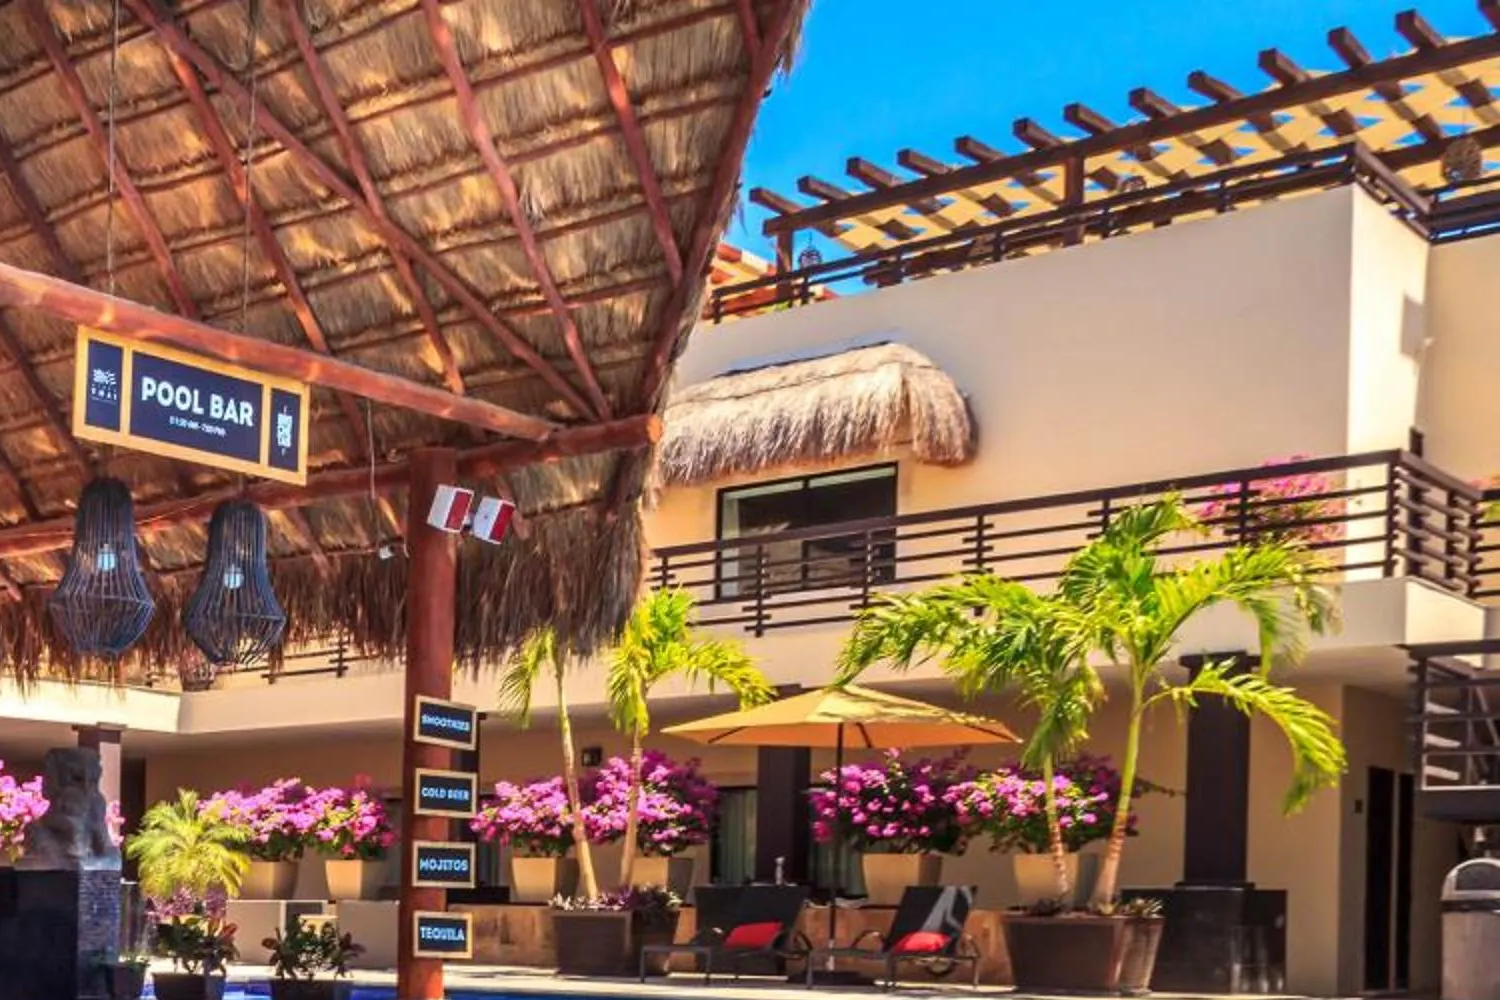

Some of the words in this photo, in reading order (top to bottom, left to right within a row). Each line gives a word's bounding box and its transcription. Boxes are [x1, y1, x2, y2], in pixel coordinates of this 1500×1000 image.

[141, 376, 204, 415] POOL
[209, 394, 254, 427] BAR
[421, 787, 446, 799] COLD
[419, 857, 469, 872] MOJITOS
[420, 926, 465, 941] TEQUILA
